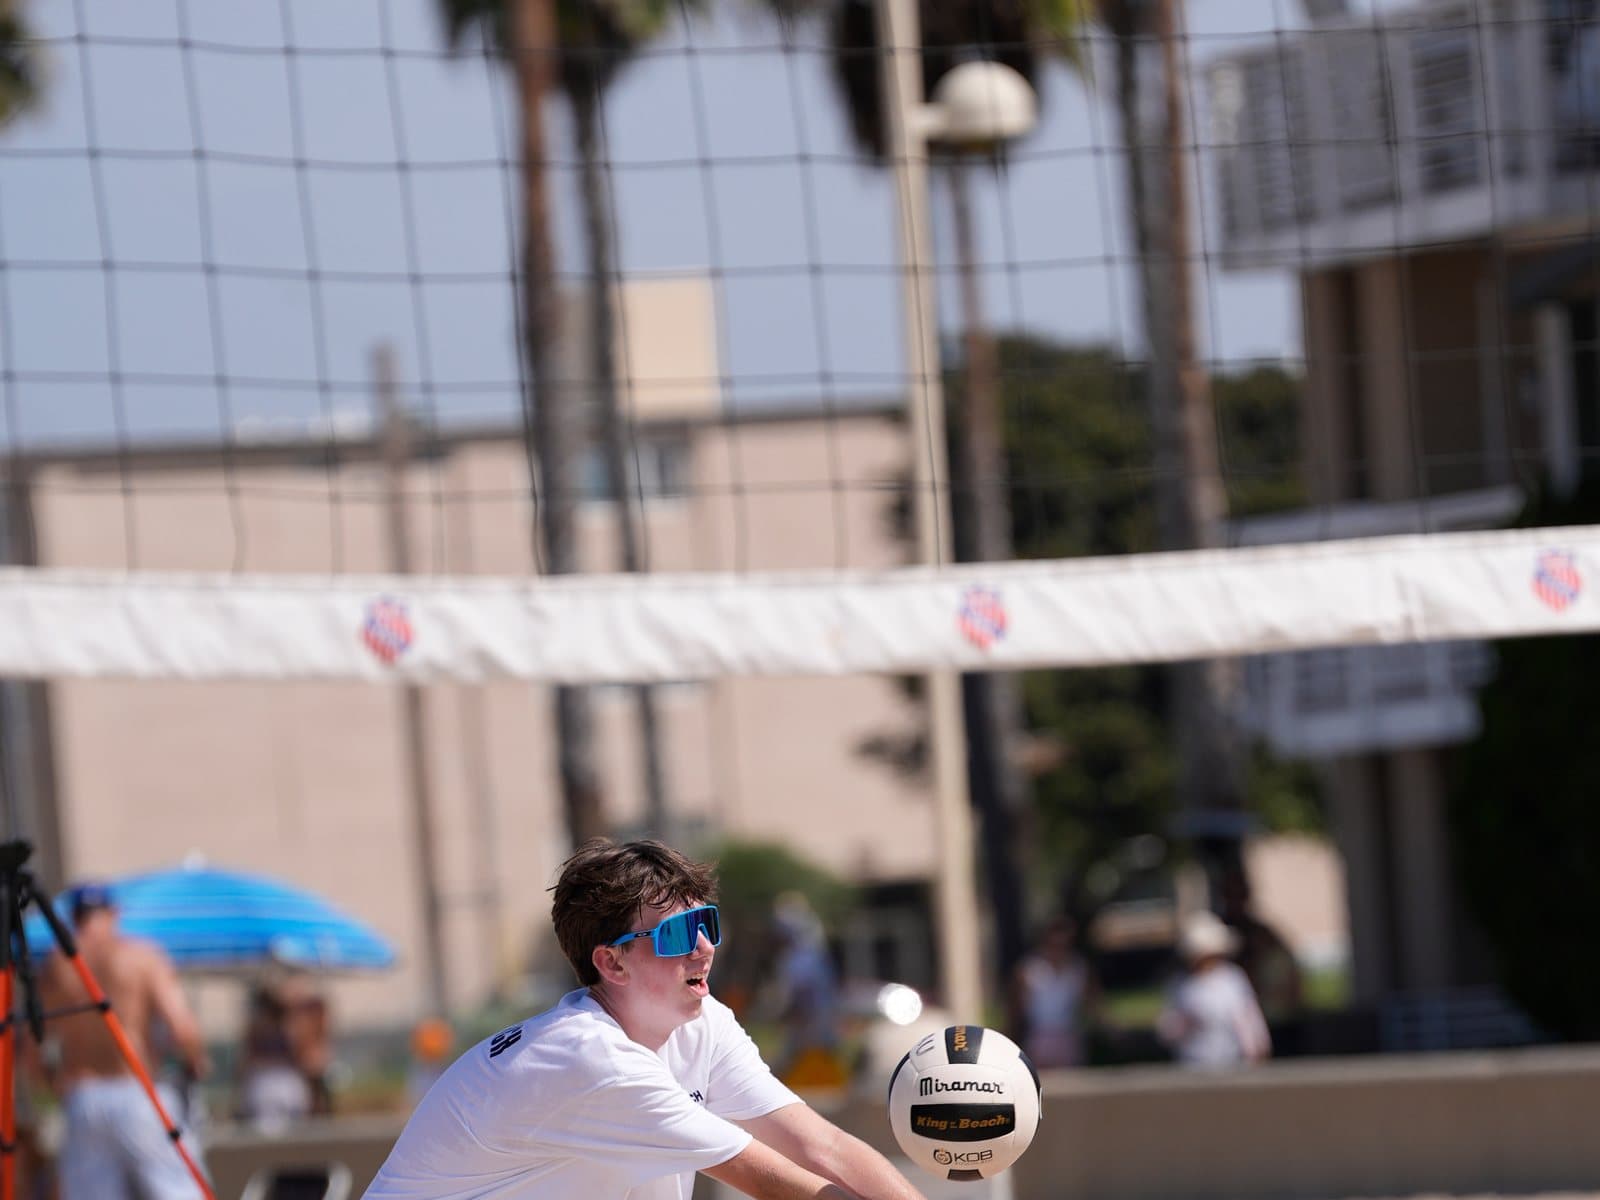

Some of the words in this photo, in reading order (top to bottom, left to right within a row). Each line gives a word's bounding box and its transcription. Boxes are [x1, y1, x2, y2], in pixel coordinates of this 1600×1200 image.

[919, 1077, 1004, 1096] Miramar
[916, 1115, 948, 1130] King
[959, 1115, 1006, 1129] Beach
[954, 1150, 993, 1162] KOB
